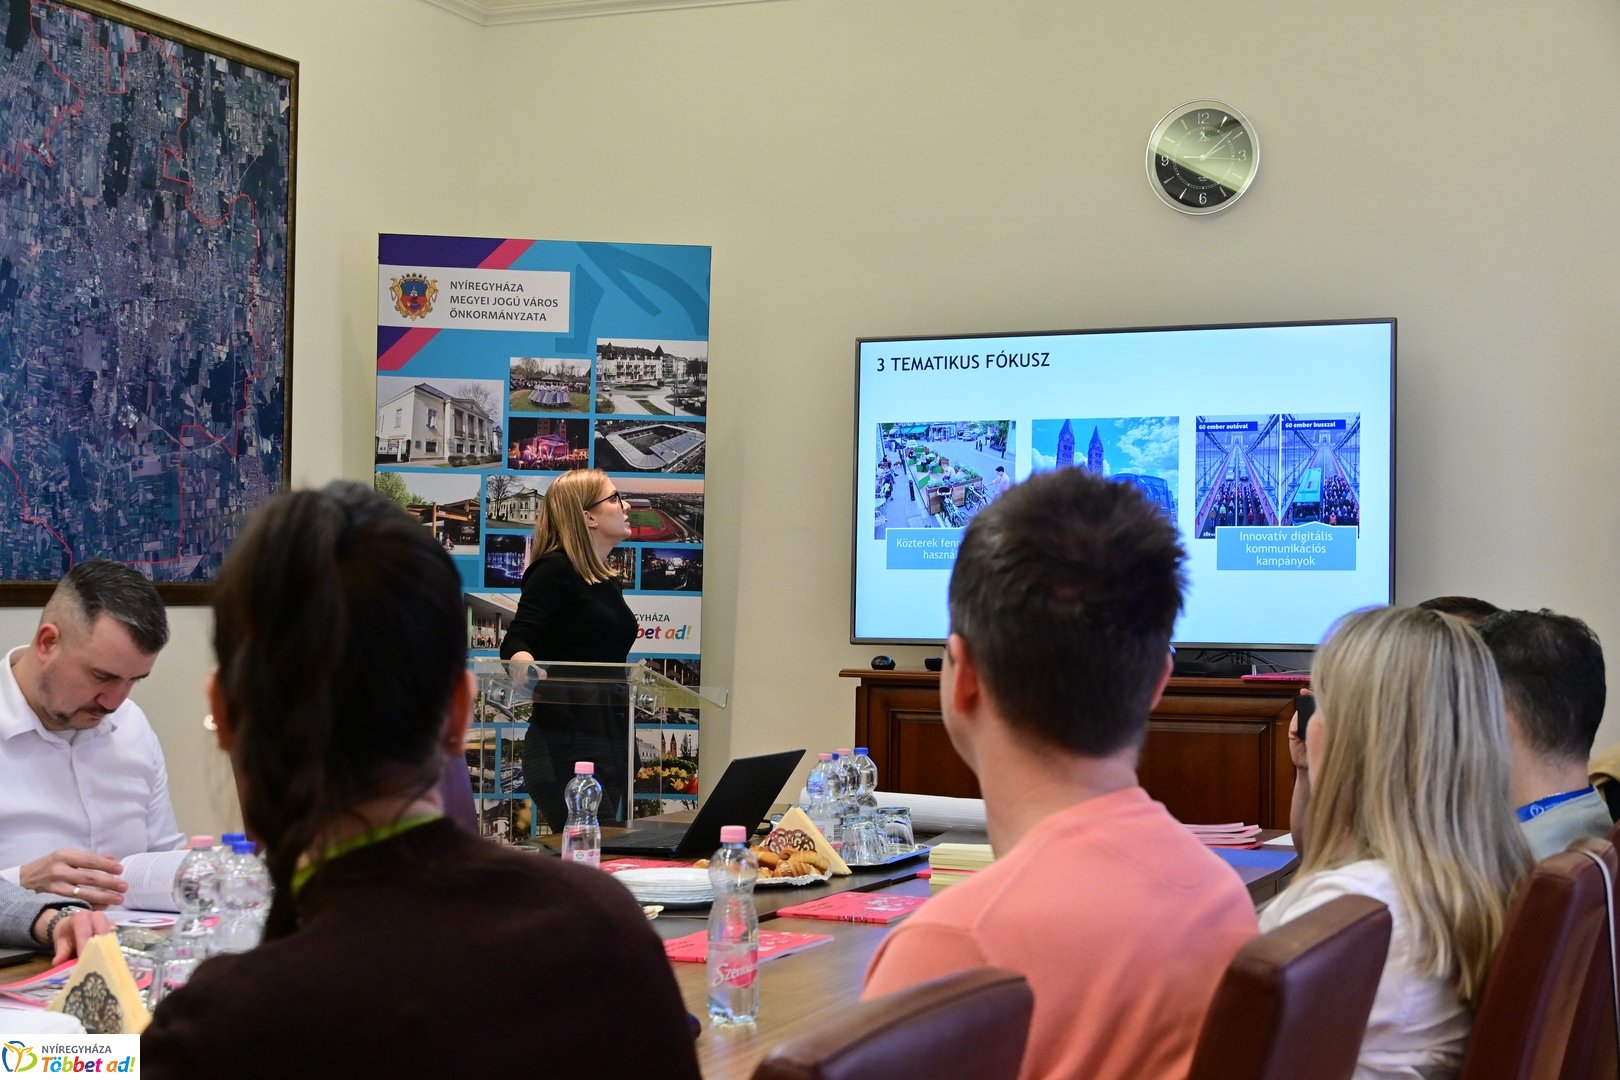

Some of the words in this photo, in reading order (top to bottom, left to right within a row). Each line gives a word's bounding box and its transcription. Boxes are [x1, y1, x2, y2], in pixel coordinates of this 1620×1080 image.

[1197, 112, 1210, 124] 12
[1238, 150, 1247, 162] 3
[1198, 192, 1207, 205] 6
[450, 280, 524, 292] NYÍREGYHÁZA
[450, 295, 490, 305] MEGYEI
[492, 296, 520, 306] JOGÚ
[524, 296, 558, 308] VÁROS
[450, 308, 547, 321] ÖNKORMÁNYZATA
[876, 358, 885, 372] 3
[891, 355, 980, 371] TEMATIKUS
[986, 350, 1050, 368] FÓKUSZ
[896, 538, 938, 548] Közterek
[1240, 532, 1287, 541] Innovatív
[1290, 532, 1333, 544] digitális
[1246, 544, 1326, 554] kommunikációs
[1256, 556, 1316, 568] kampányok
[664, 624, 692, 640] ad!
